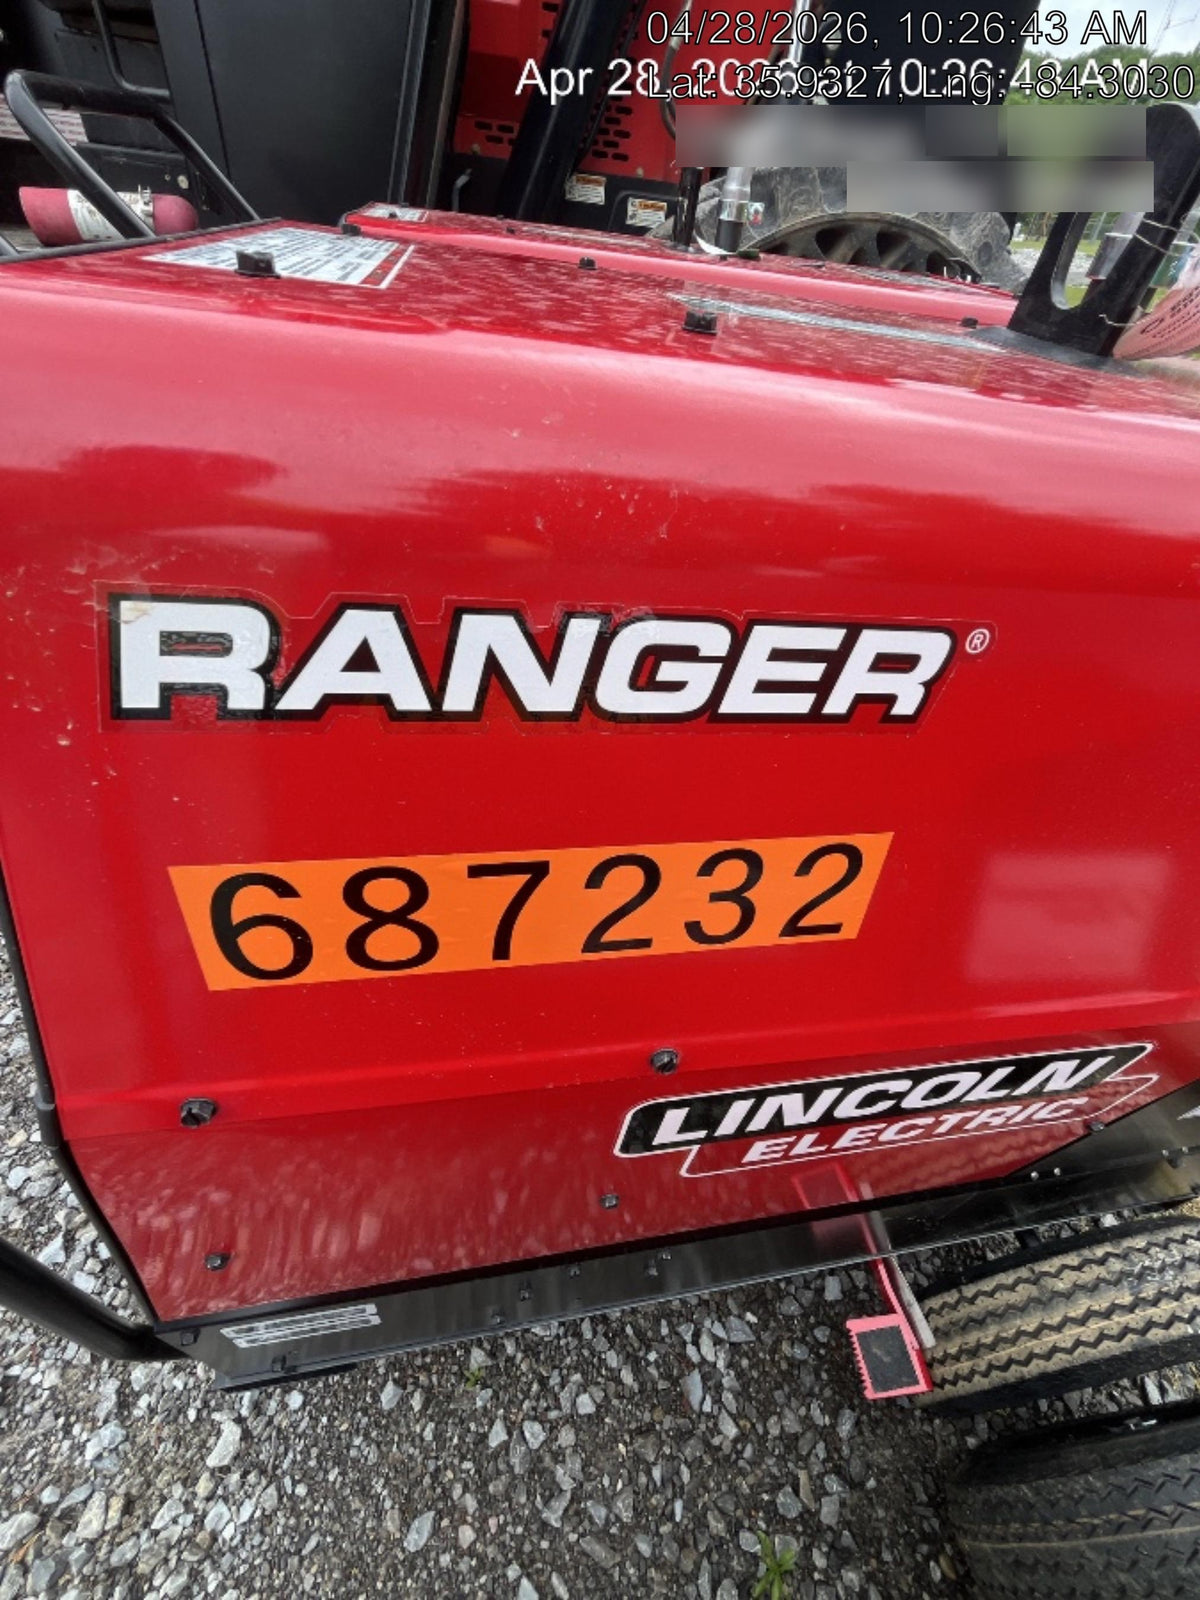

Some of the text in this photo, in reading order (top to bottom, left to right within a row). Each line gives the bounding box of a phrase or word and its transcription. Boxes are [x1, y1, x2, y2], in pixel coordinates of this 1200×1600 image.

[115, 596, 954, 720] RANGER
[209, 843, 864, 981] 687232
[652, 1055, 1116, 1146] LINCOLN
[741, 1096, 1090, 1164] ELECTRIC
